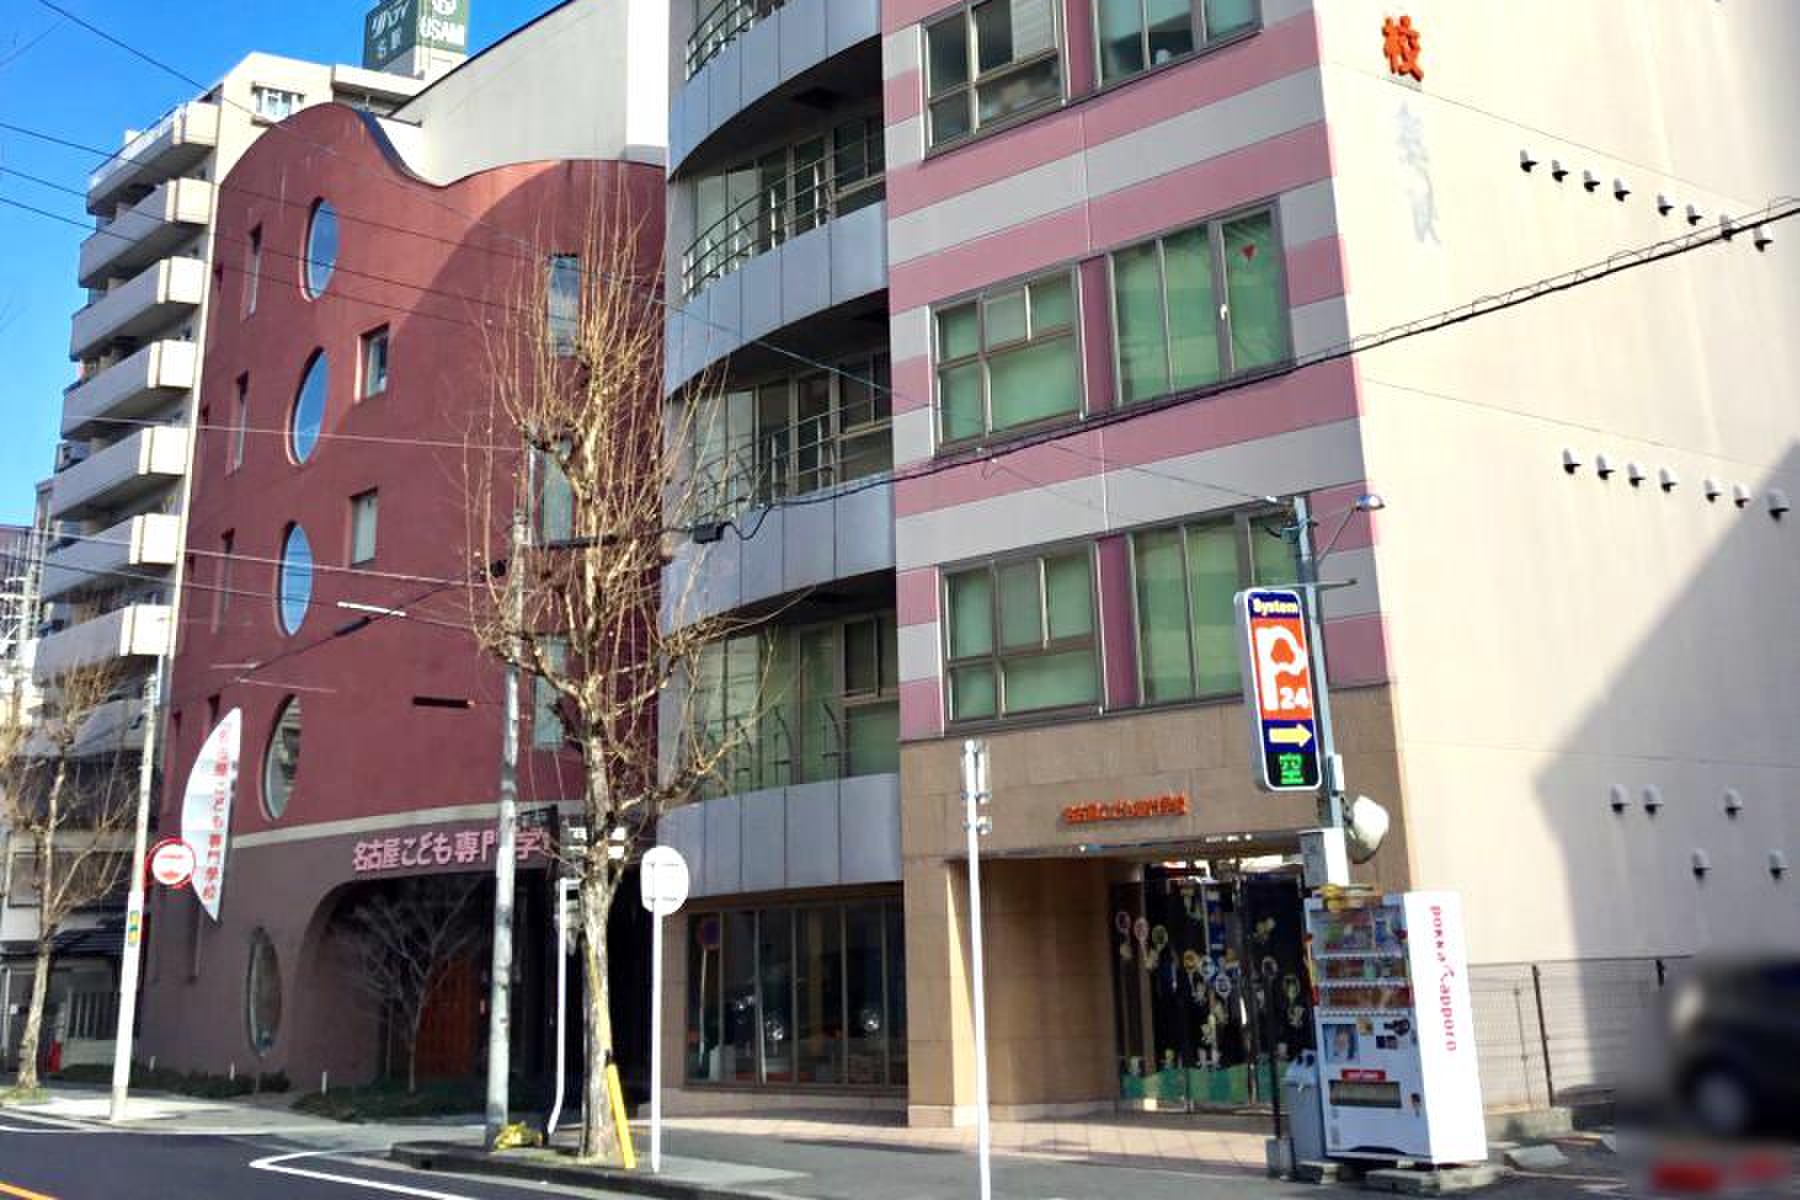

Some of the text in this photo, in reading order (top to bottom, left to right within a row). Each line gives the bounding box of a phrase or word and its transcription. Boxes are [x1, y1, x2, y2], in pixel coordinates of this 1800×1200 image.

[1253, 598, 1299, 616] System
[1256, 625, 1306, 711] P
[1279, 686, 1311, 710] 24
